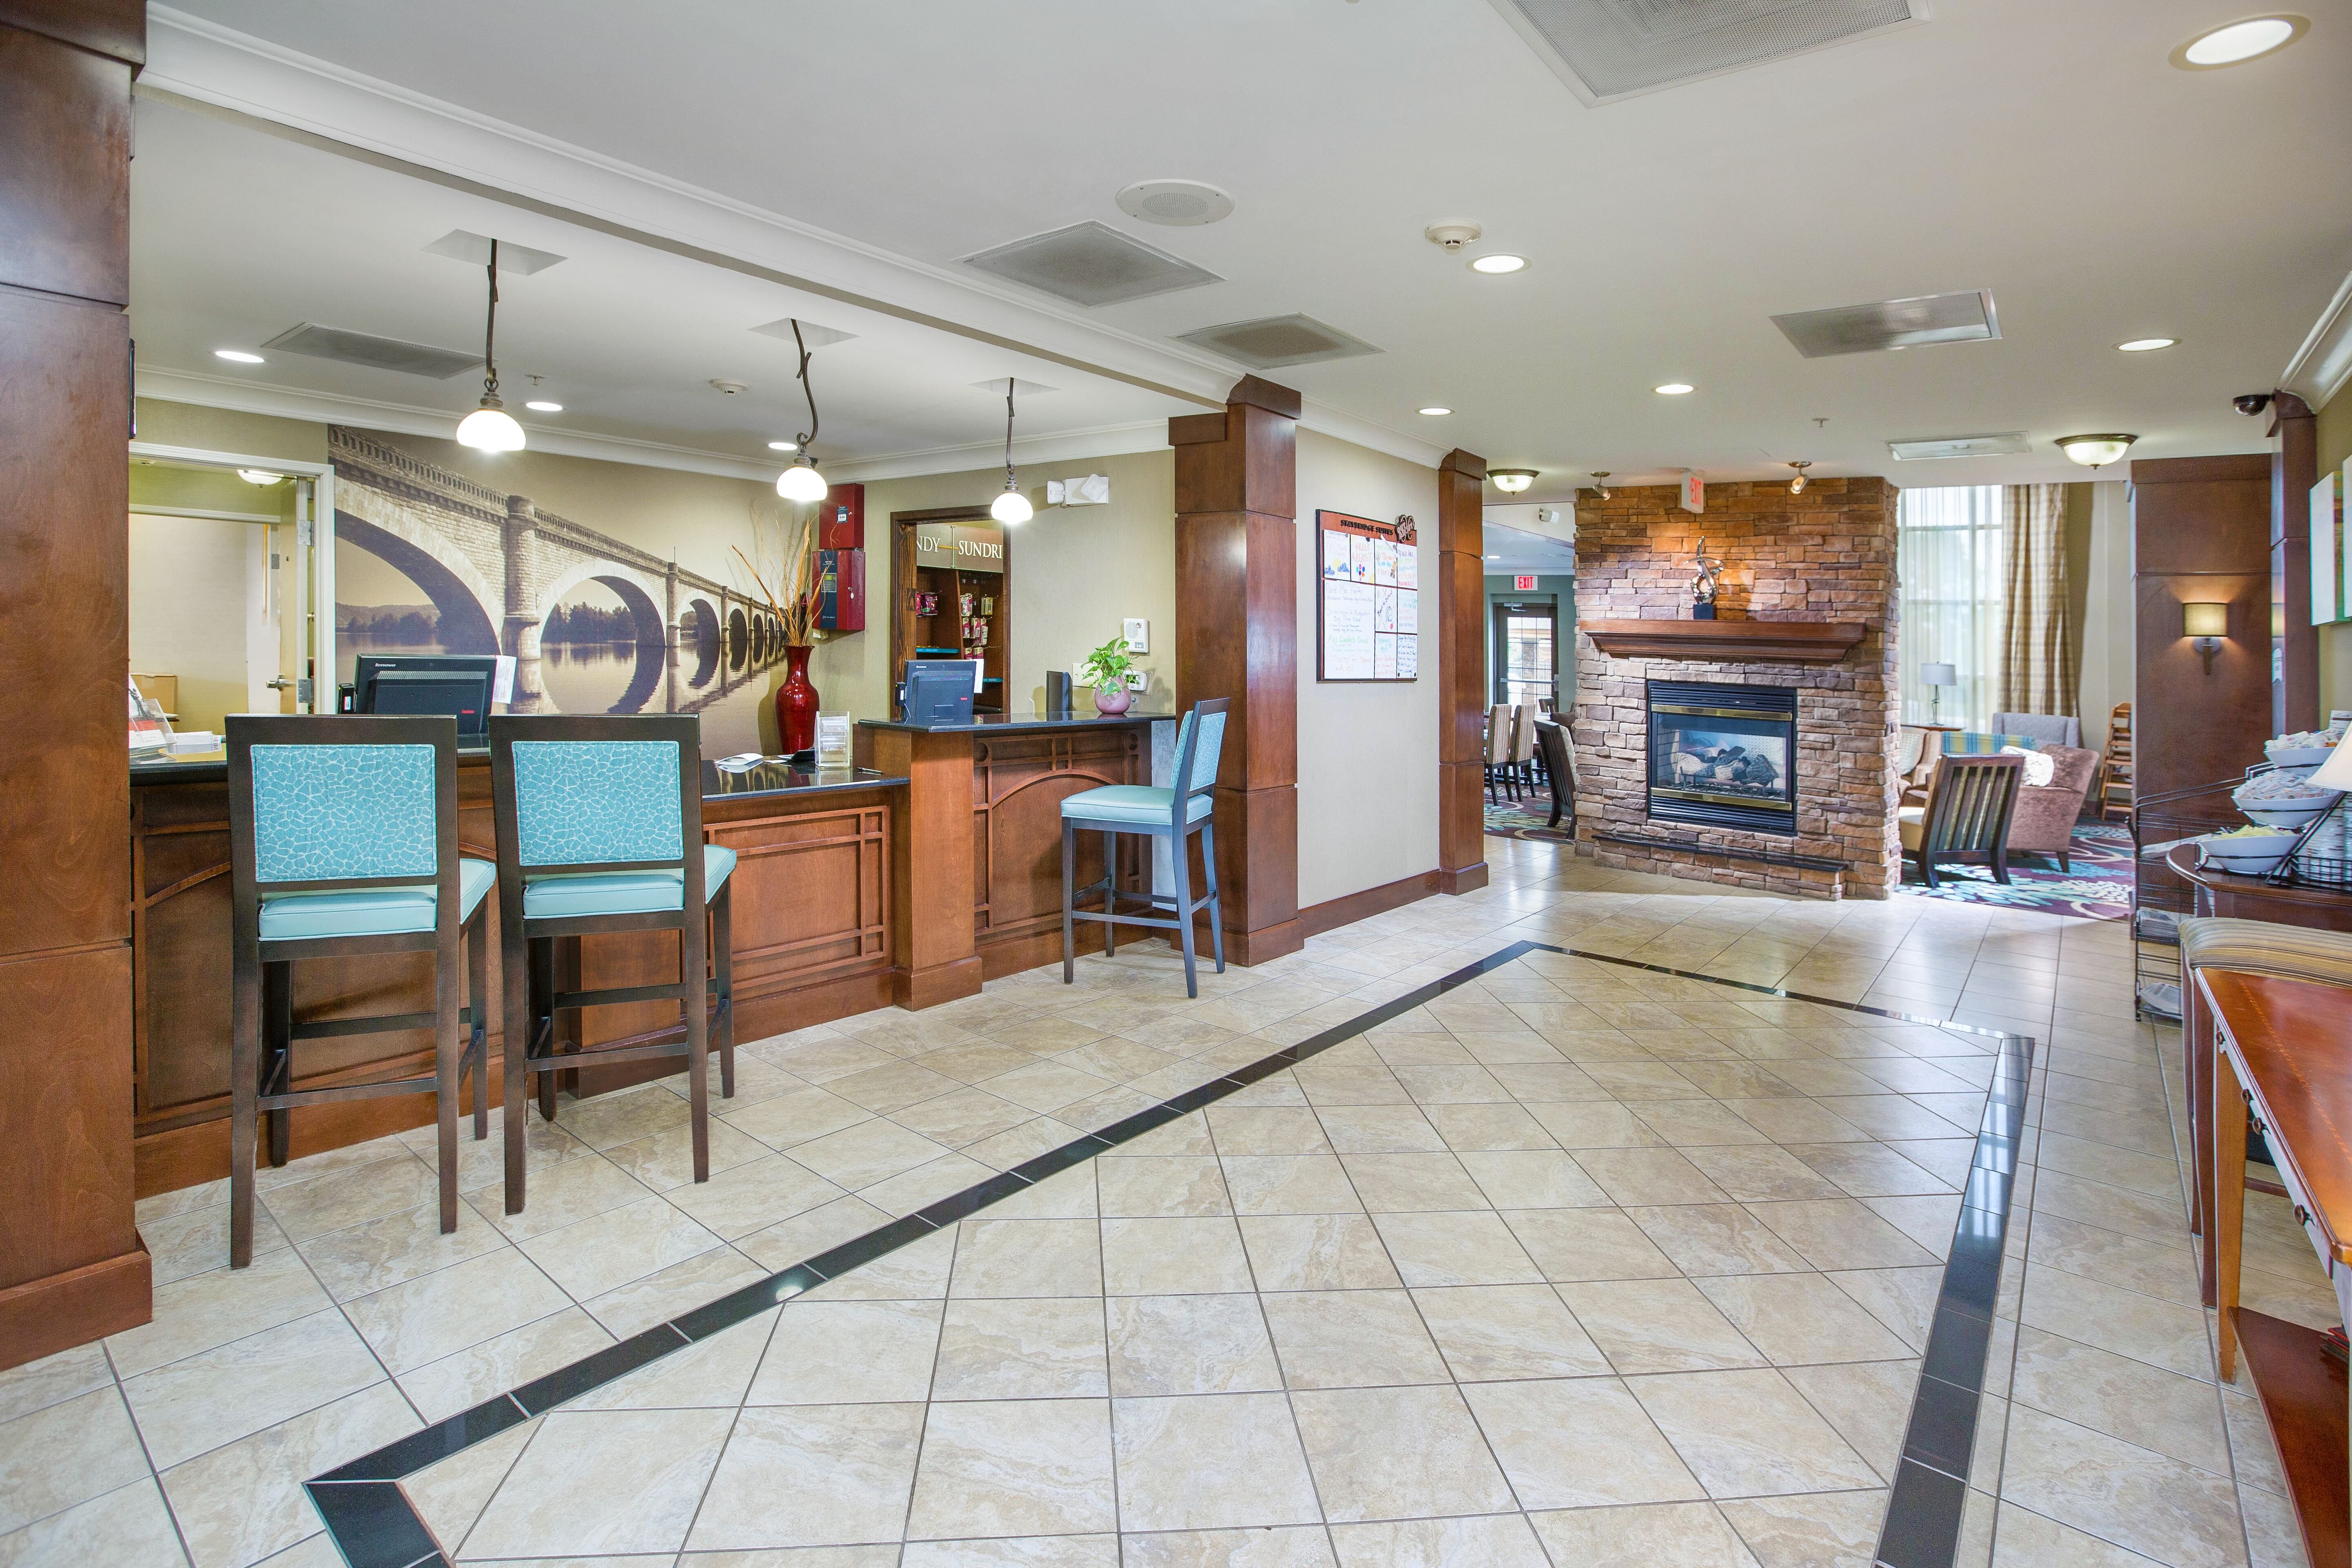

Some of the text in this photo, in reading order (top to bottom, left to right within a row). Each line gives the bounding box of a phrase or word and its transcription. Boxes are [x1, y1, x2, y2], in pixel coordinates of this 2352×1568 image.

[1691, 477, 1702, 506] EXIT
[1341, 519, 1393, 536] STAYBRIDGE SUITES
[958, 540, 1003, 559] SUNDRI
[1519, 576, 1534, 589] EXIT
